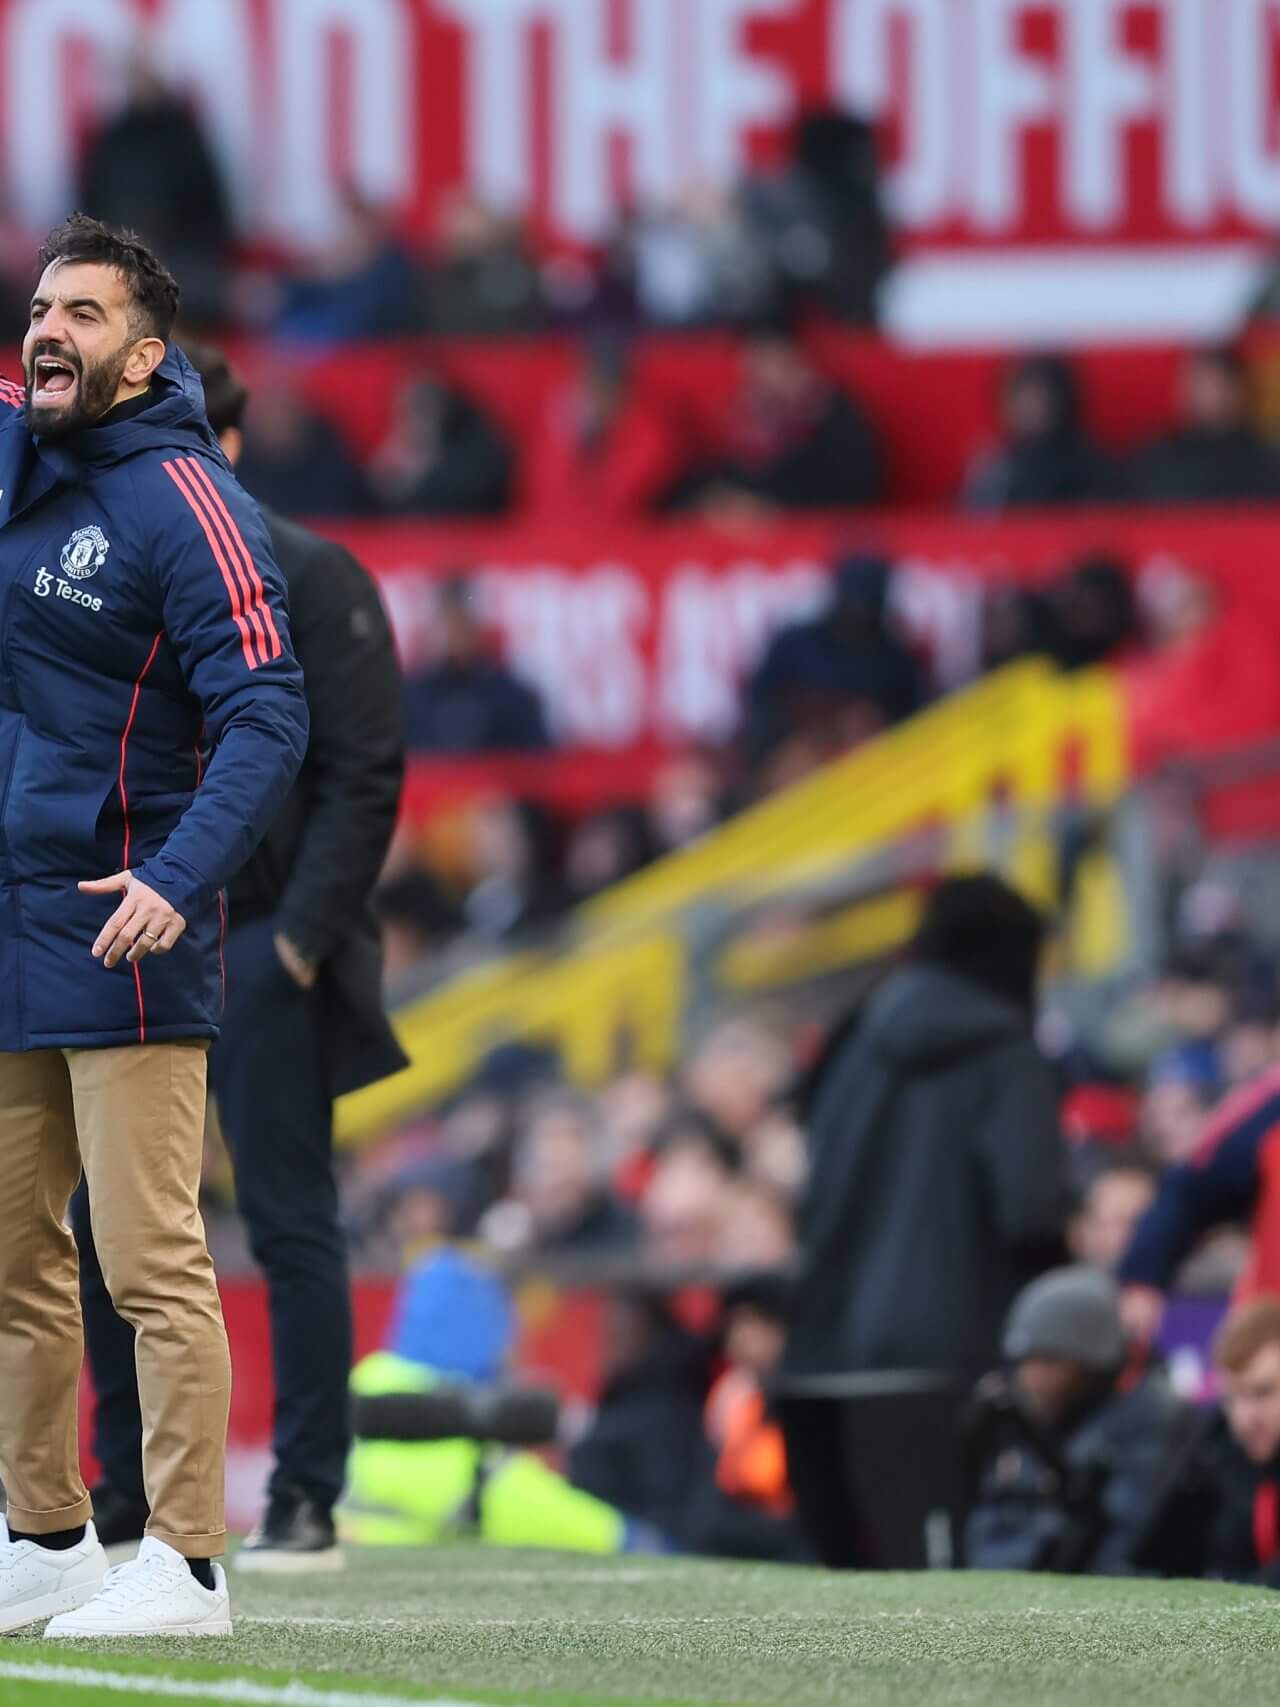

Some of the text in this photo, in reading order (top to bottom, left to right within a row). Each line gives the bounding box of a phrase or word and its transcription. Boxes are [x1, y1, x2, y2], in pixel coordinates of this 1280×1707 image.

[431, 0, 801, 242] THE
[63, 561, 91, 576] UNITED
[56, 578, 103, 612] Tezos
